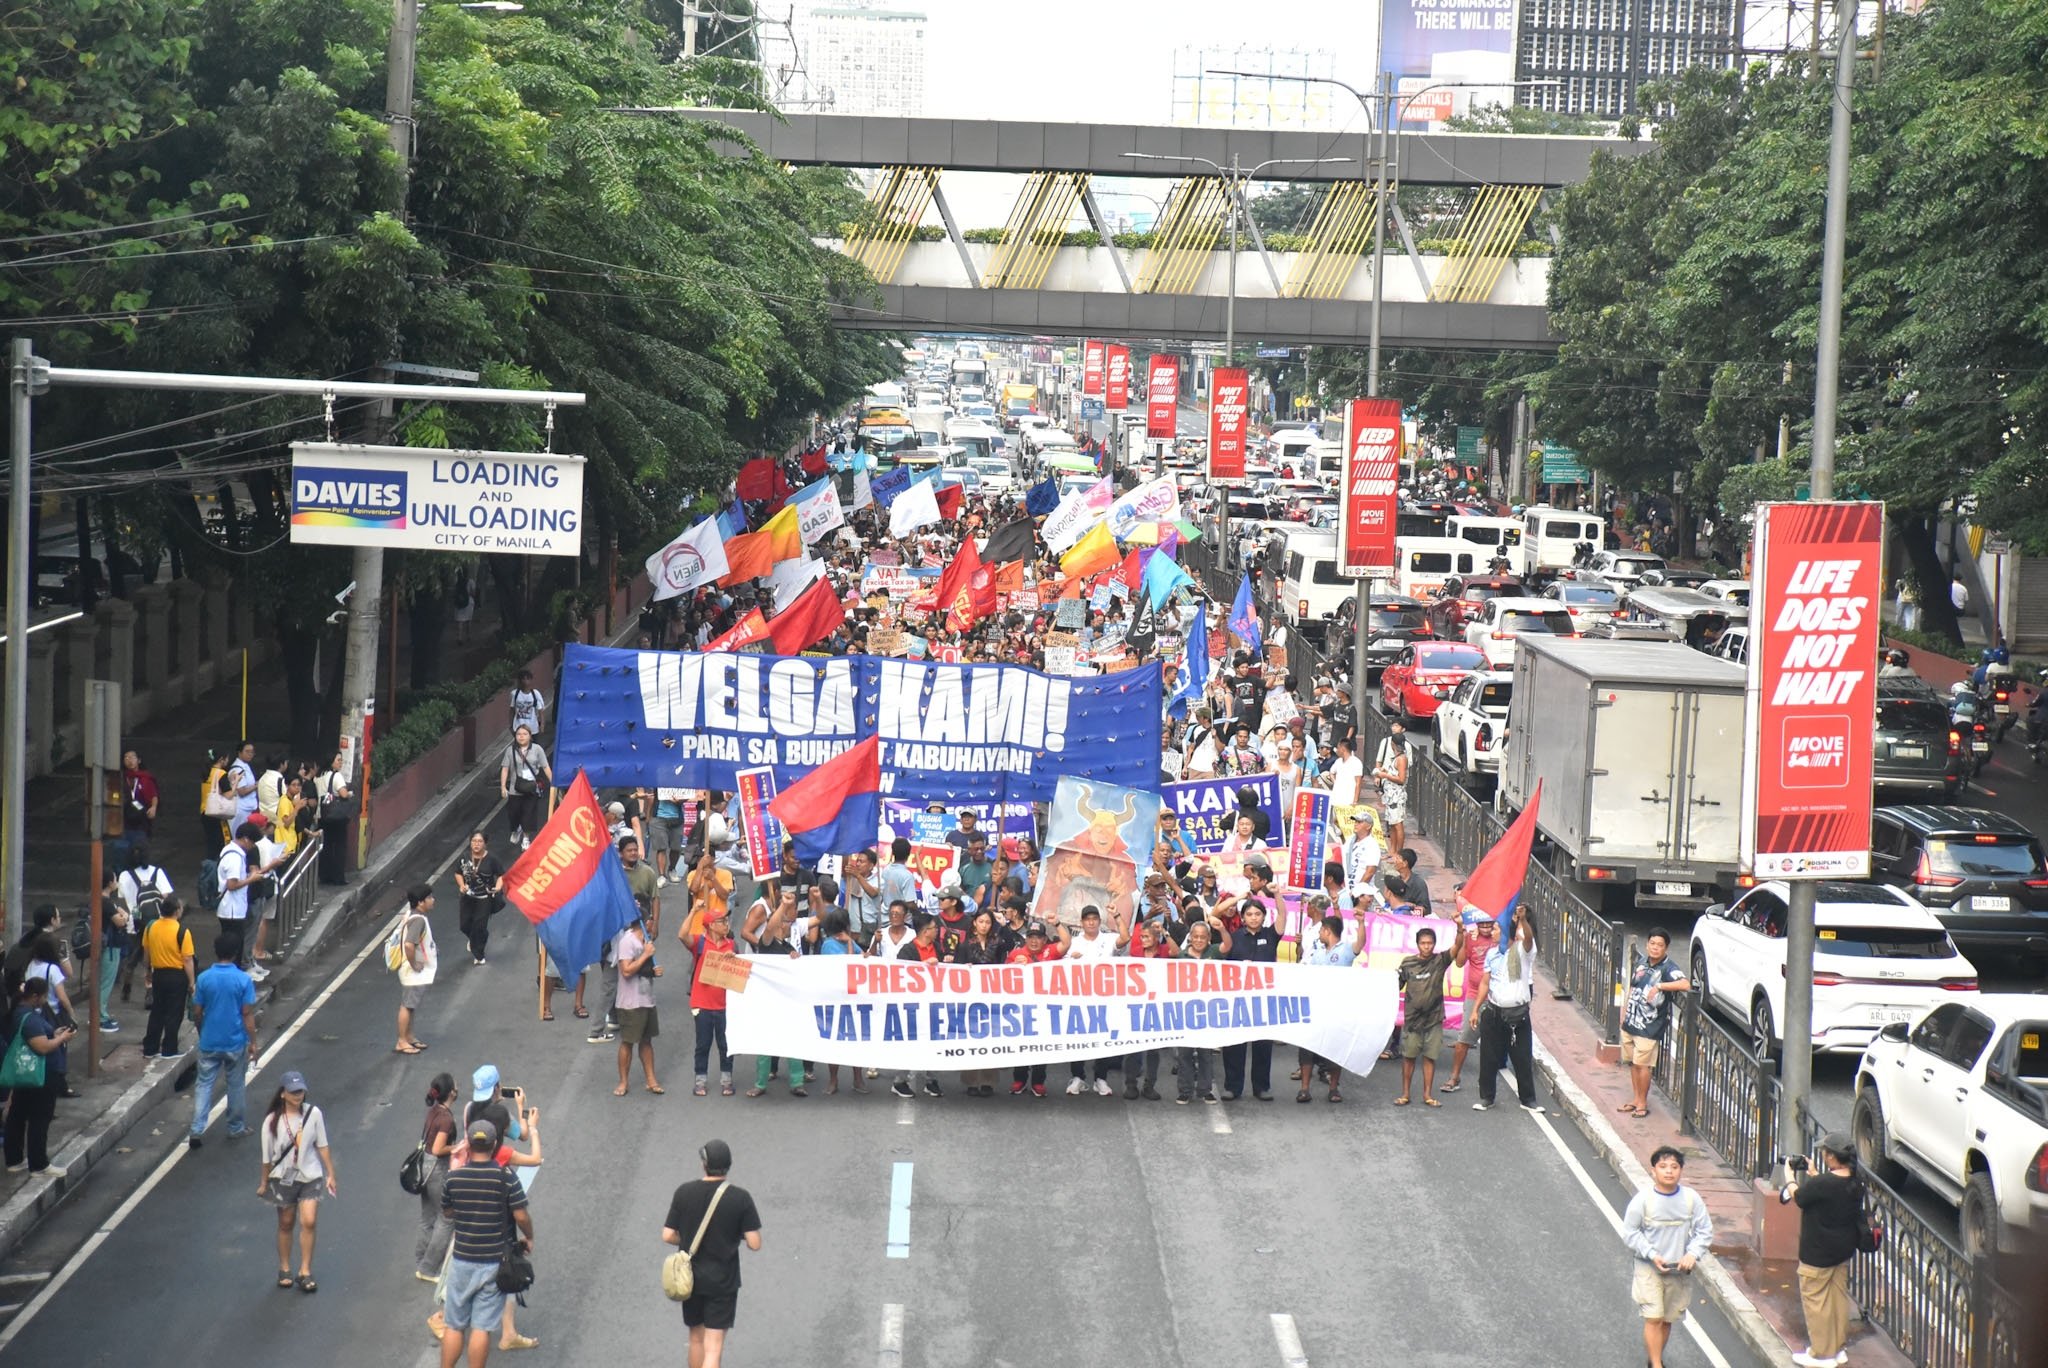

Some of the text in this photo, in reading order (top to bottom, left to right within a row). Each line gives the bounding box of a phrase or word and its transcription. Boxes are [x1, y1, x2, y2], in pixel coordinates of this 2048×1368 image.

[1415, 11, 1512, 30] THERE WILL BE
[1154, 368, 1175, 377] KEEP
[1218, 386, 1243, 396] DON'T
[1222, 395, 1238, 404] LET
[1214, 404, 1246, 413] TRAFFIC
[1218, 413, 1239, 423] STOP
[1220, 422, 1238, 432] YOU
[1357, 428, 1395, 444] KEEP
[433, 459, 559, 488] LOADING
[297, 479, 401, 506] DAVIES
[479, 491, 513, 502] AND
[353, 507, 390, 515] Reinvented
[411, 503, 577, 533] UNLOADING
[1360, 510, 1384, 518] MOVE
[435, 533, 552, 549] CITY OF MANILA
[877, 568, 901, 579] VAT
[1785, 559, 1862, 595] LIFE
[1773, 597, 1869, 632] DOES
[1781, 634, 1857, 669] NOT
[1771, 671, 1865, 706] WAIT
[638, 652, 1071, 753] WELGA KAMI!
[1788, 736, 1844, 752] MOVE
[682, 734, 740, 762] PARA
[748, 737, 778, 764] SA
[894, 741, 1033, 775] KABUHAYAN!
[992, 804, 1028, 818] ANG
[1186, 816, 1207, 830] SA
[517, 832, 583, 902] PISTON
[1293, 840, 1304, 886] CALUMPIT
[847, 962, 1275, 1001] PRESYO NG LANGIS, IBABA!
[814, 995, 1311, 1042] VAT AT EXCISE TAX, TANGGALIN!
[1870, 1012, 1911, 1022] ARL 0429
[970, 1047, 988, 1056] TO
[992, 1046, 1015, 1054] OIL
[1019, 1043, 1063, 1053] PRICE
[1067, 1041, 1100, 1050] HIKE
